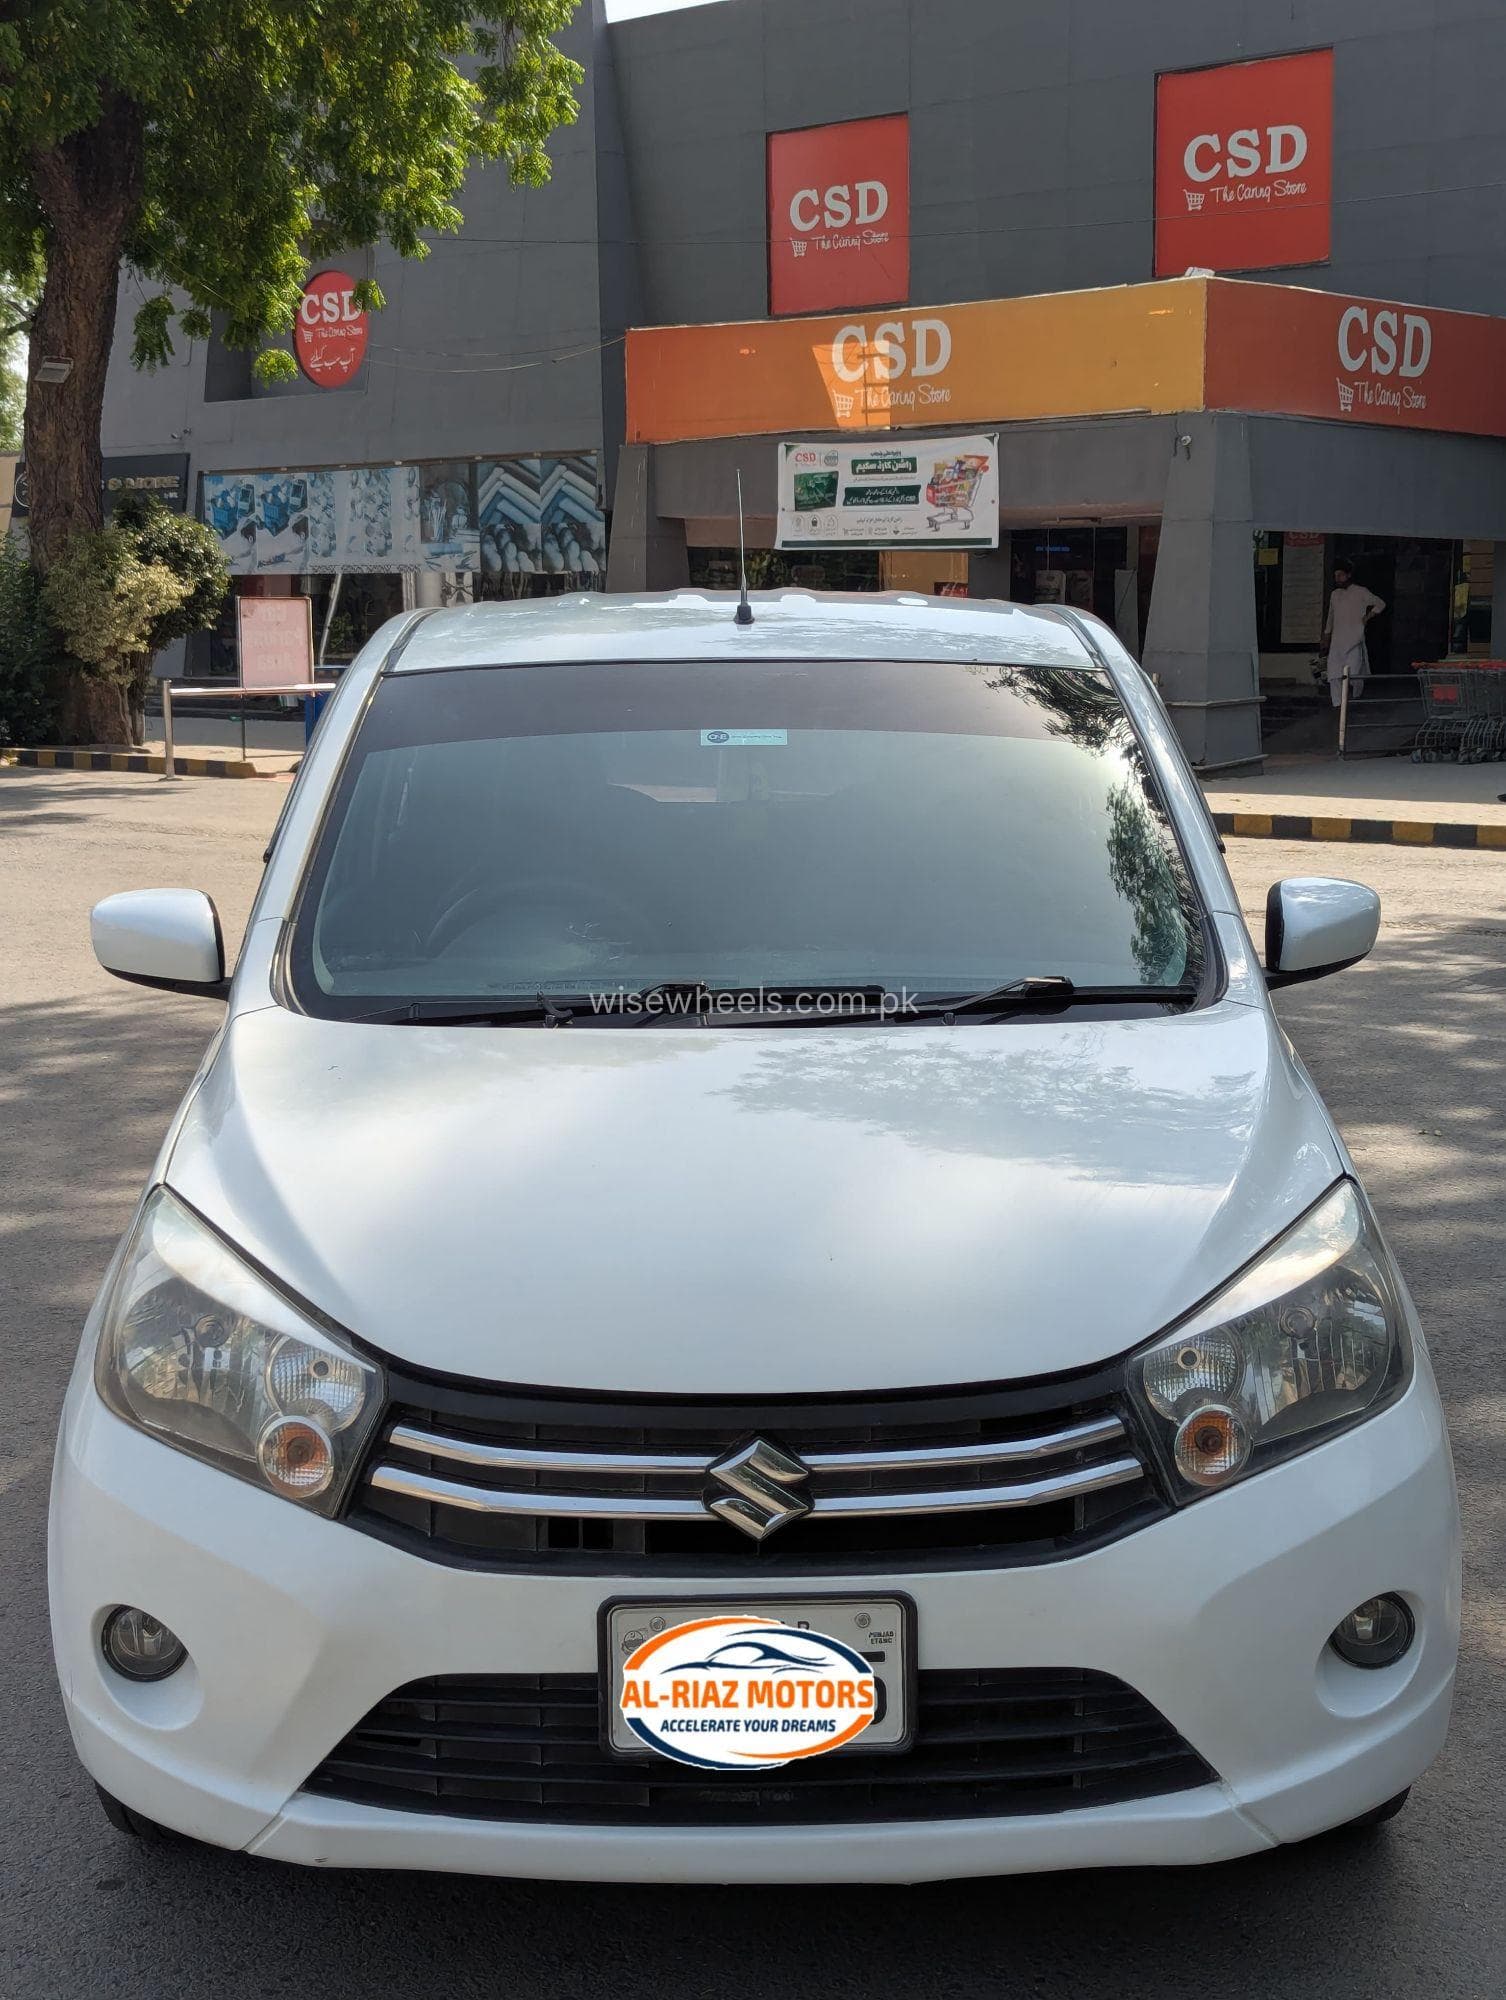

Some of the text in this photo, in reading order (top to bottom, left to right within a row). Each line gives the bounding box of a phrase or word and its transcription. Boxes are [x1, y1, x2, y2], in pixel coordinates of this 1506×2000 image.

[1184, 125, 1307, 182] CSD
[790, 181, 888, 232] CSD
[1210, 180, 1307, 202] The Caring Store
[812, 230, 889, 251] The Caring Store
[301, 291, 361, 324] CSD
[832, 320, 951, 382] CSD
[1338, 306, 1431, 377] CSD
[855, 384, 951, 411] The Caring Store
[1354, 381, 1426, 415] The Caring Store
[795, 453, 816, 463] CSD
